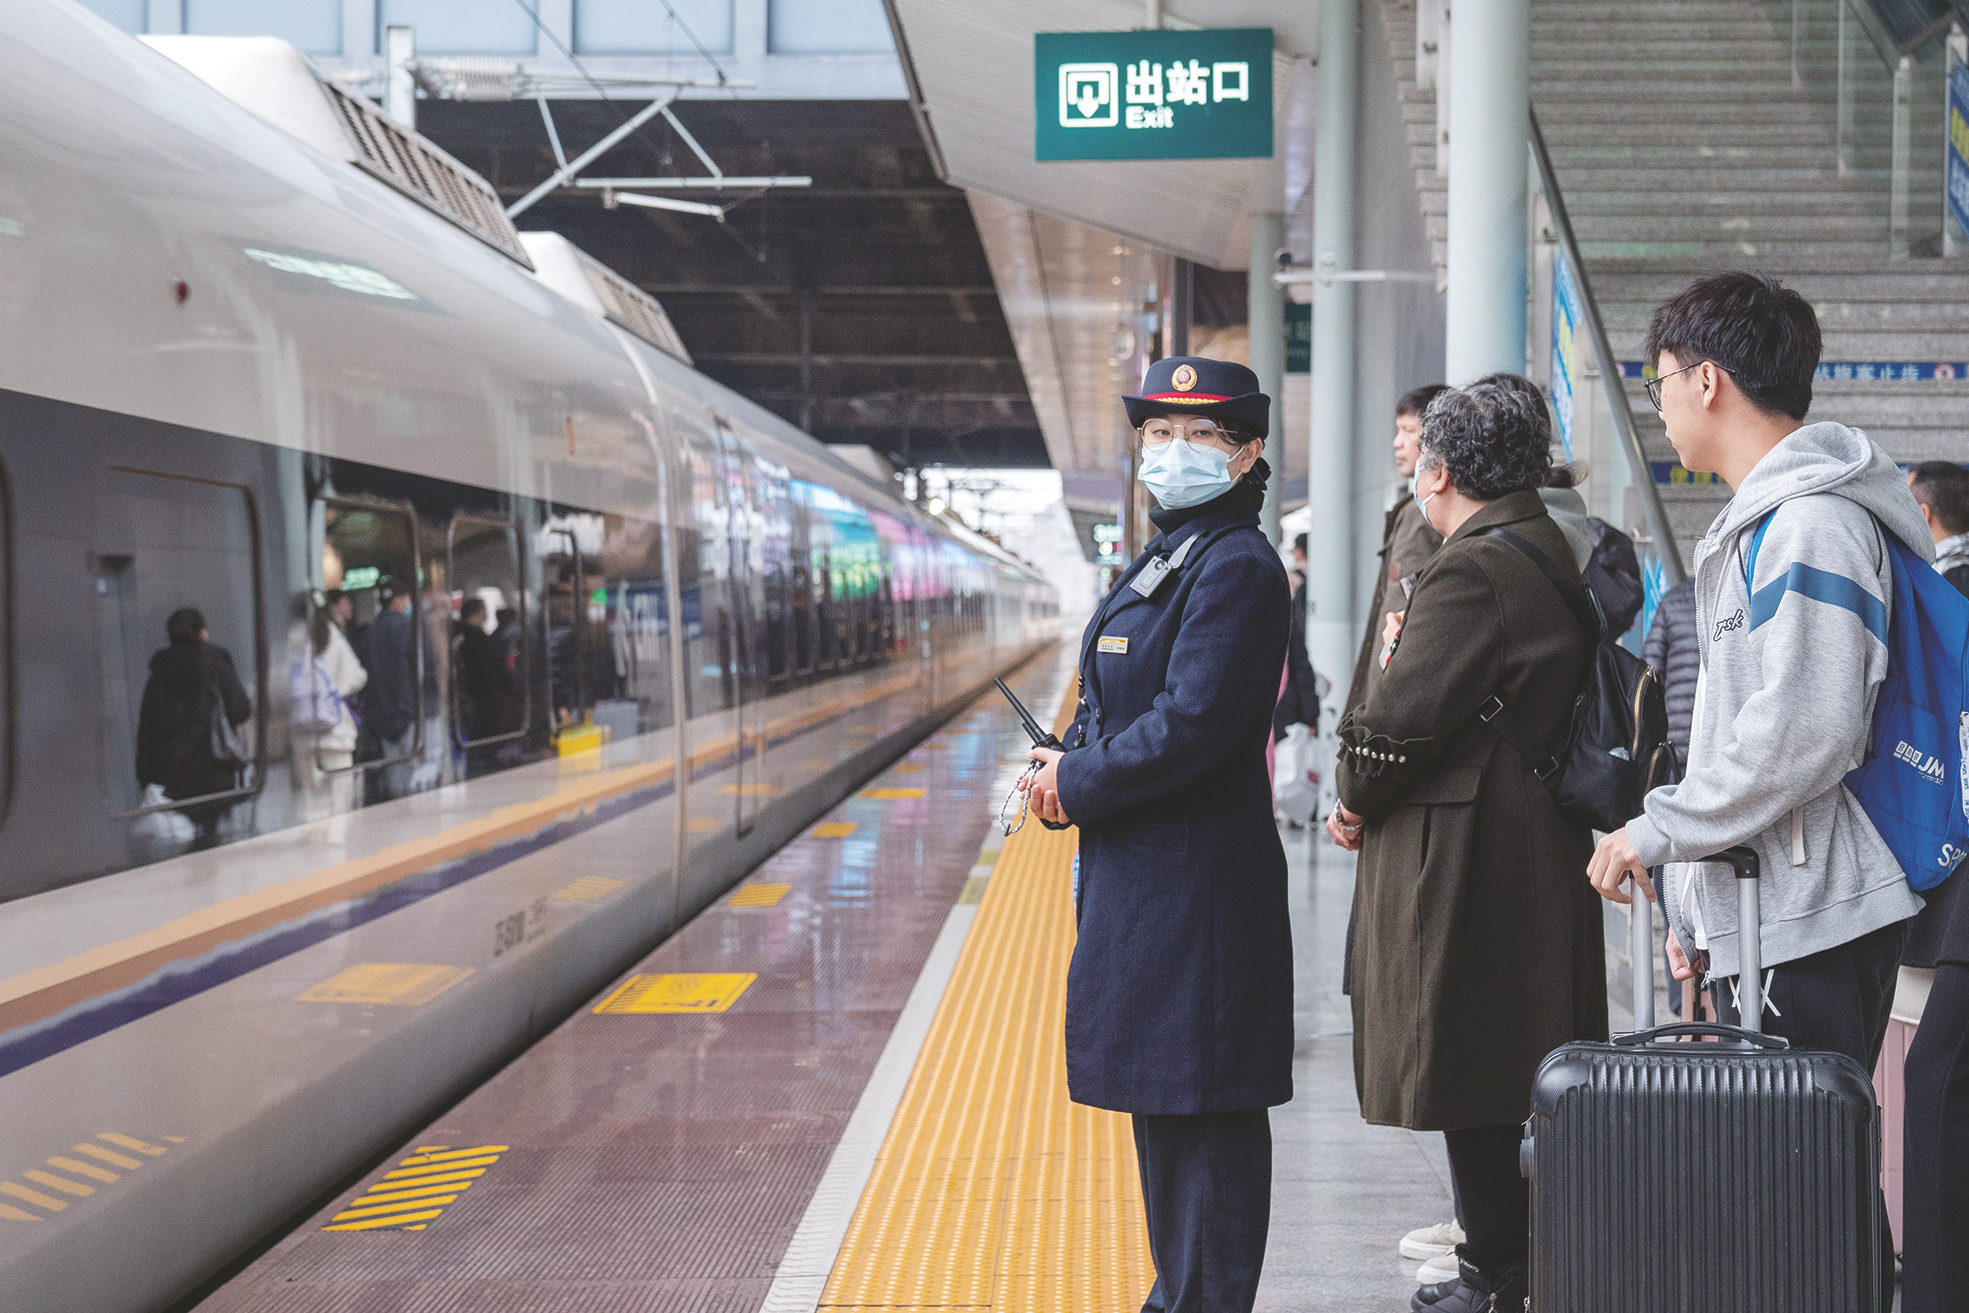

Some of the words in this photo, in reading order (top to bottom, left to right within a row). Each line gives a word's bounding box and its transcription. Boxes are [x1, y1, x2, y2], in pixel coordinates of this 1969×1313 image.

[1125, 59, 1249, 106] 出站口
[1125, 105, 1174, 129] Exit
